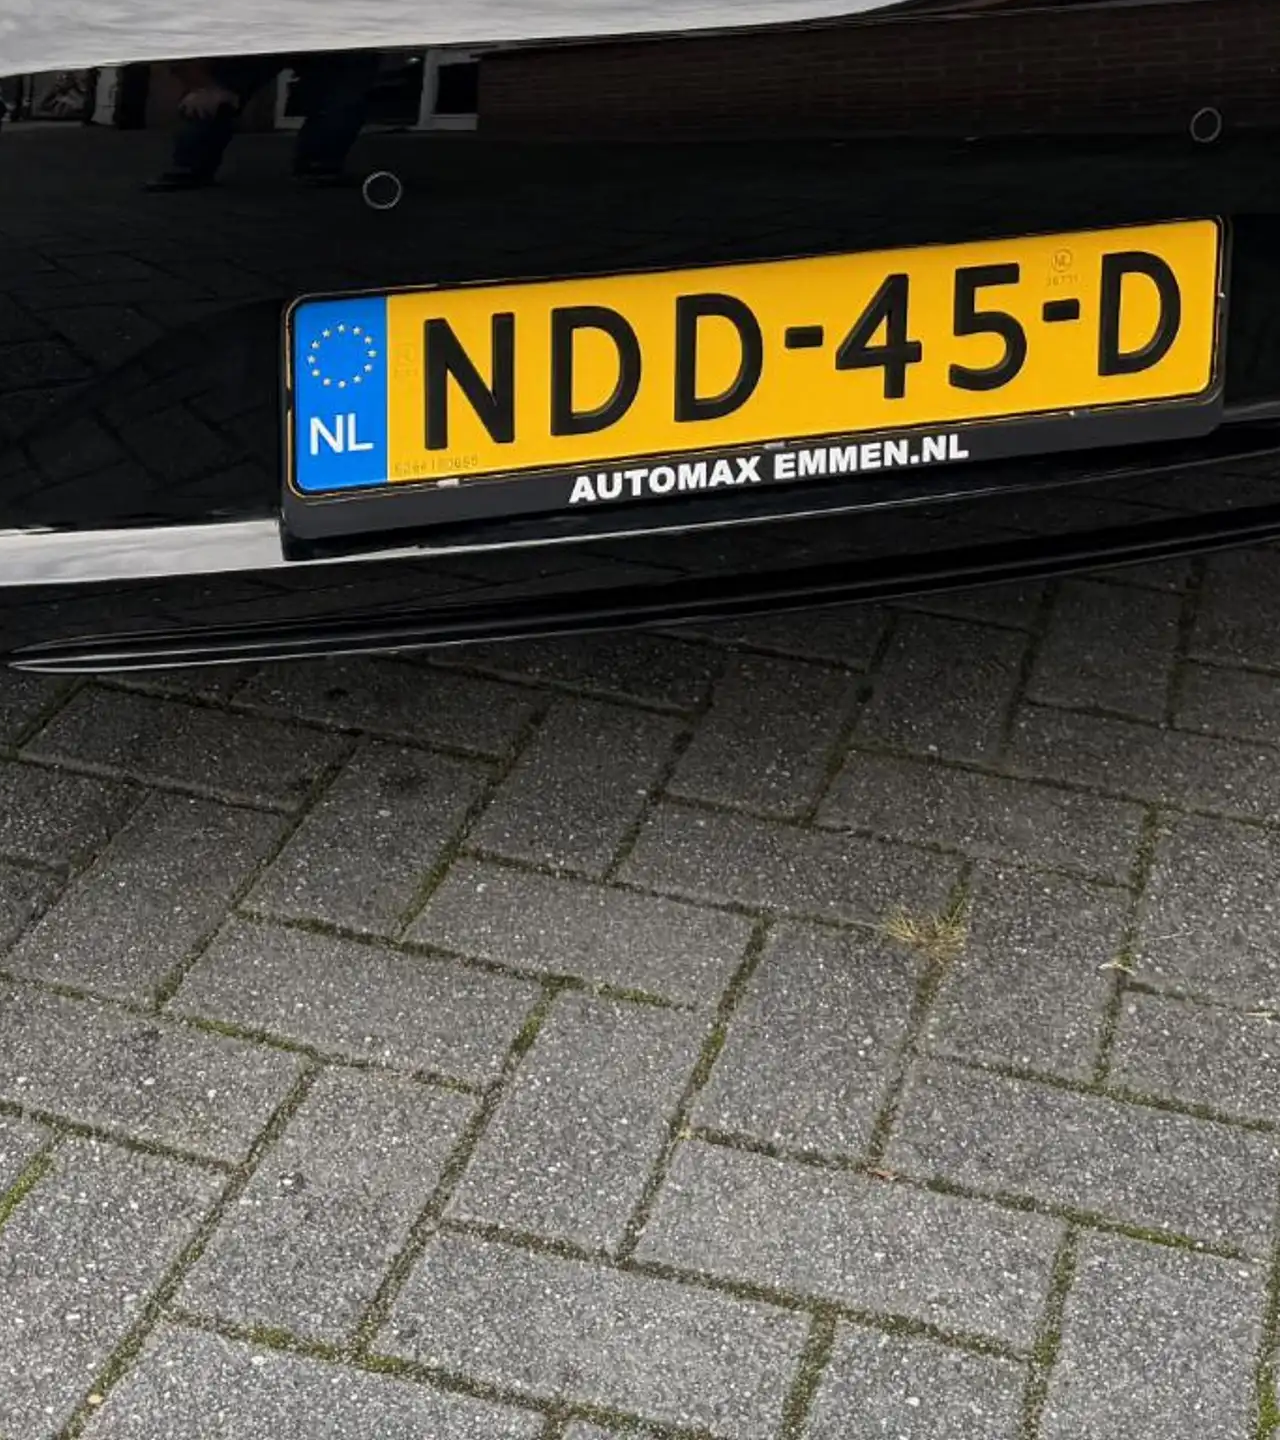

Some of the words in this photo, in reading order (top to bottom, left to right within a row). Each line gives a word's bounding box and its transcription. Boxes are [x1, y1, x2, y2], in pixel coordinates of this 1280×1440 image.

[308, 412, 374, 456] NL
[424, 250, 1183, 451] NDD-45-D
[569, 454, 762, 504] AUTOMAX
[774, 433, 970, 481] EMMEN.NL
